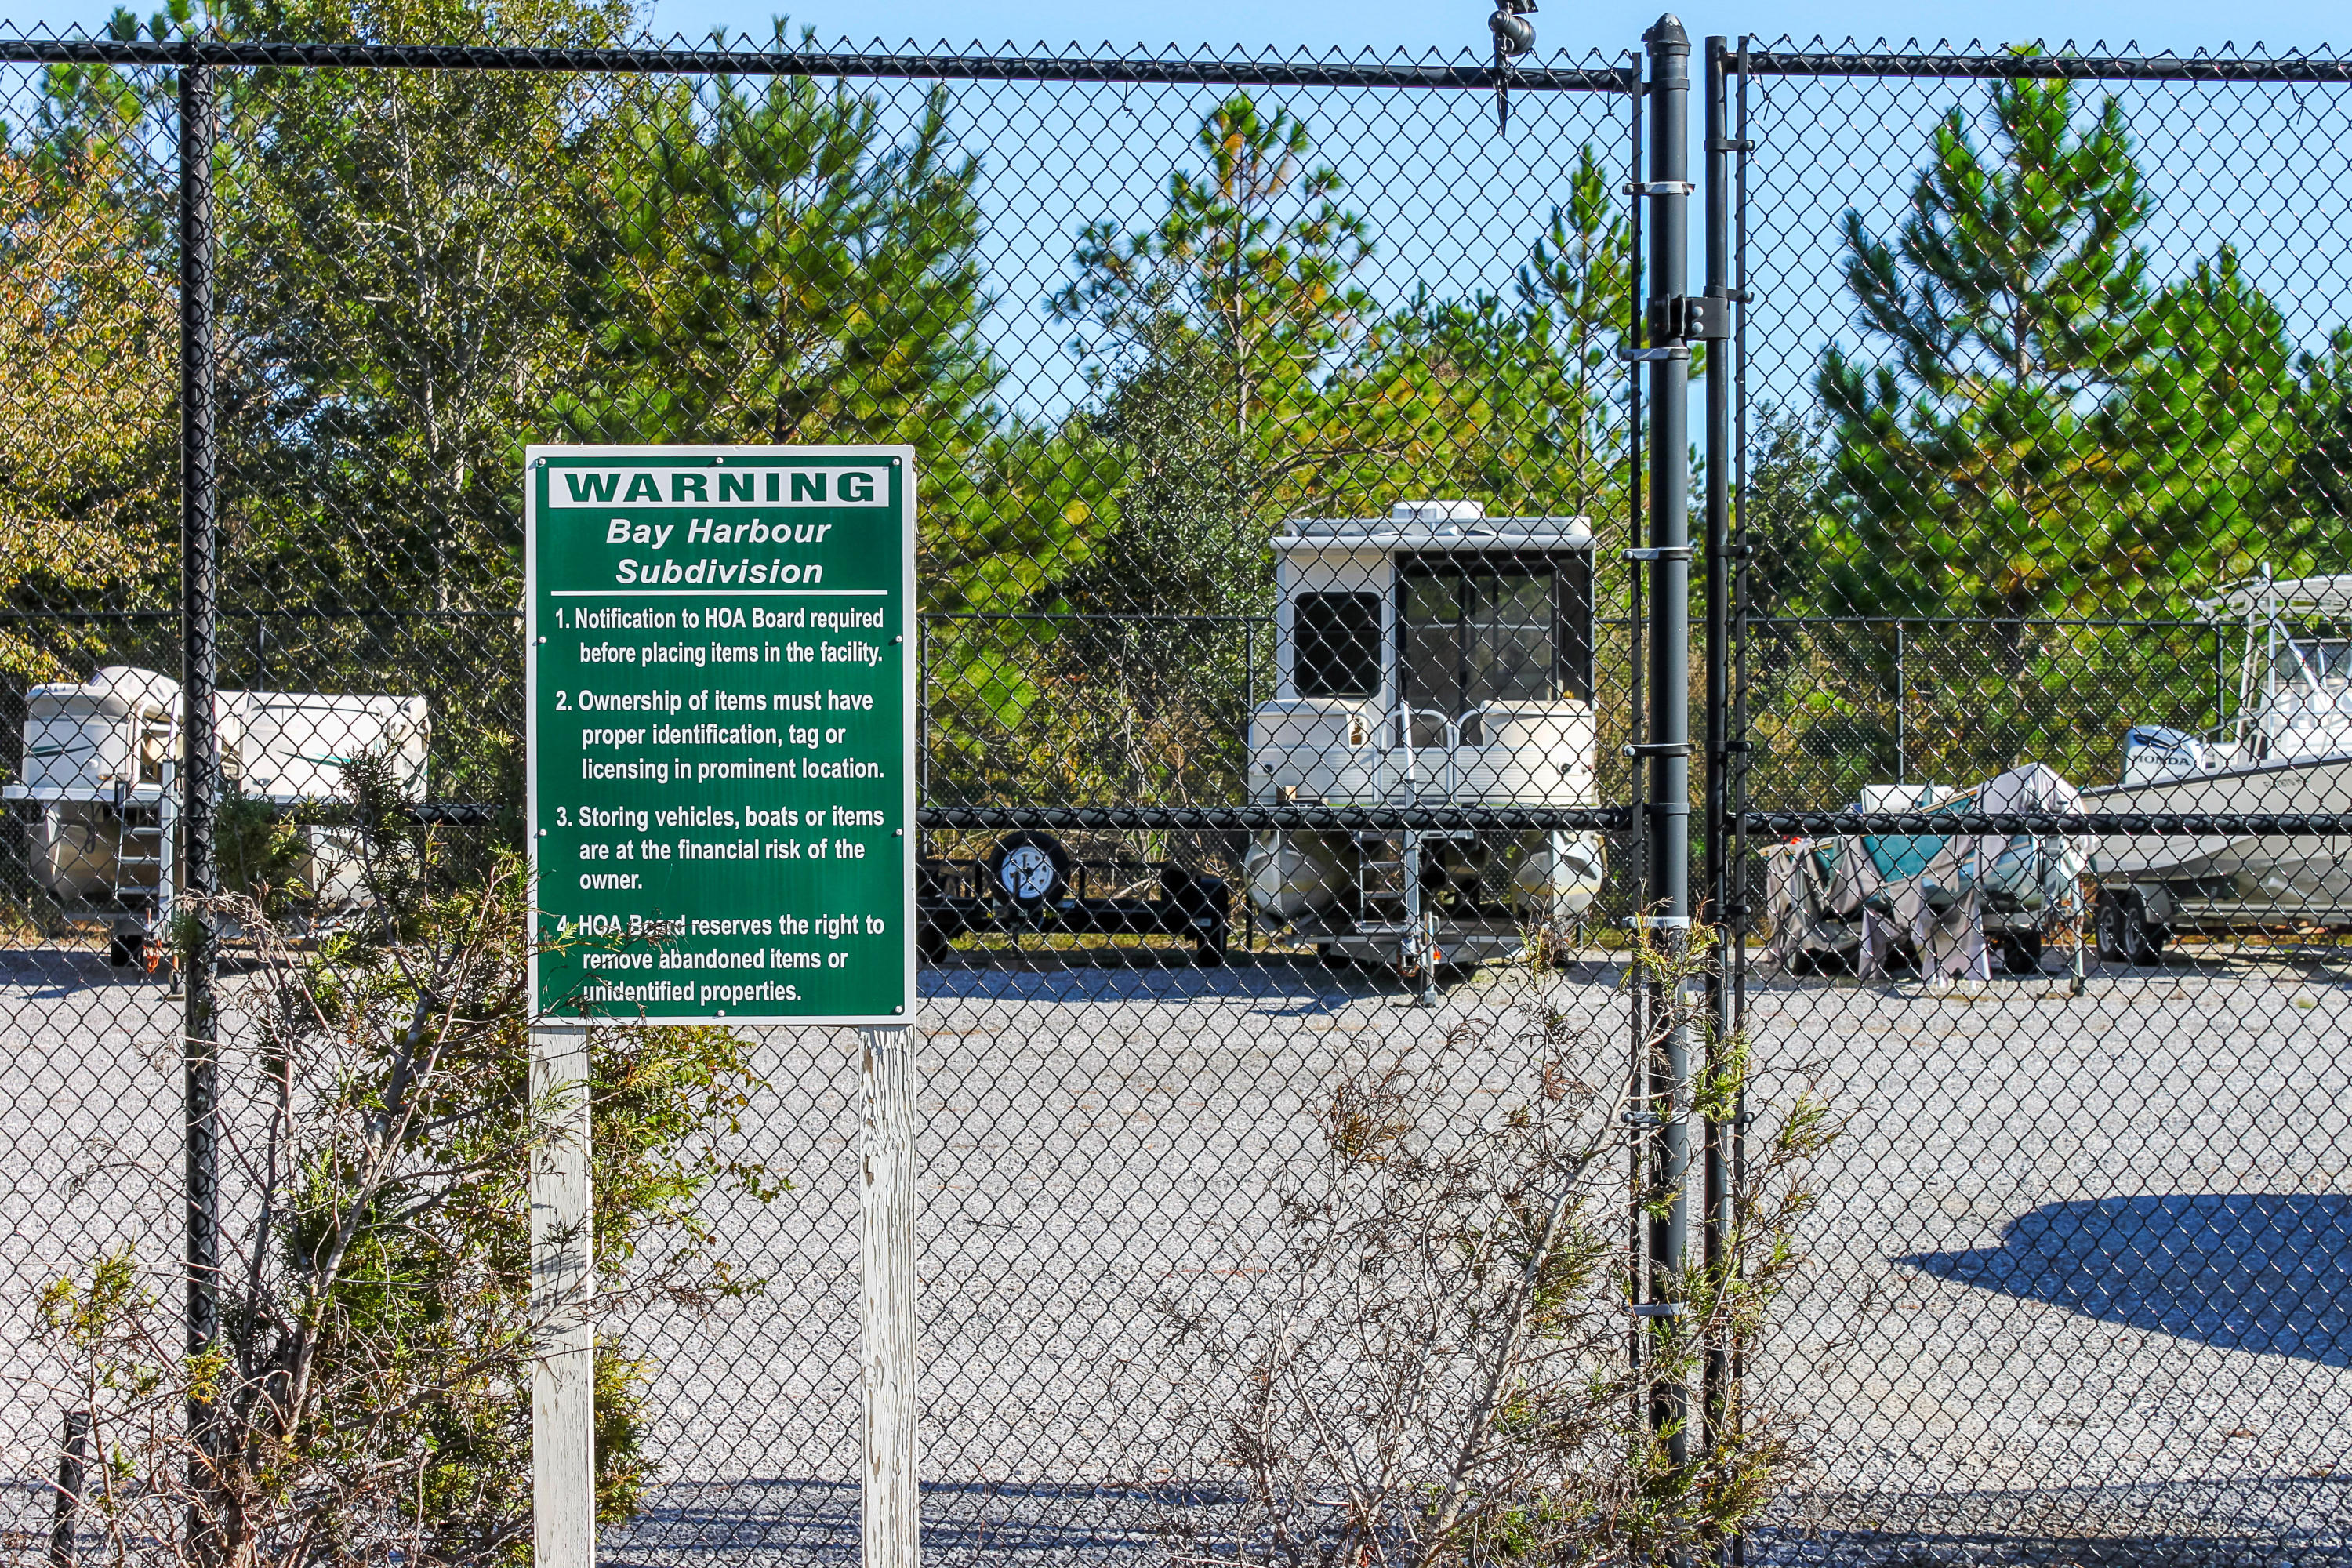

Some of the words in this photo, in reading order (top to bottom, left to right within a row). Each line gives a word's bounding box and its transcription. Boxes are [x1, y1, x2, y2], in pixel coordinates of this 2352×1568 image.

[564, 472, 874, 503] WARNING
[606, 518, 675, 550] Bay
[687, 518, 832, 543] Harbour
[615, 558, 823, 584] Subdivision
[555, 608, 570, 629] 1.
[575, 608, 676, 629] Notification
[682, 609, 699, 628] to
[705, 608, 746, 629] HOA
[753, 608, 804, 628] Board
[811, 608, 884, 633] required
[580, 642, 636, 663] before
[641, 642, 706, 667] placing
[711, 642, 759, 662] items
[764, 641, 780, 662] in
[786, 641, 815, 662] the
[820, 641, 883, 667] facility.
[555, 691, 572, 711] 2.
[578, 690, 682, 715] Ownership
[688, 690, 709, 710] of
[715, 690, 767, 710] items
[773, 691, 822, 710] must
[828, 690, 873, 710] have
[582, 728, 647, 750] proper
[652, 724, 782, 748] identification,
[789, 724, 819, 749] tag
[825, 728, 847, 744] or
[583, 758, 669, 783] licensing
[674, 758, 691, 779] in
[698, 758, 797, 783] prominent
[802, 758, 884, 779] location.
[556, 807, 572, 827] 3.
[579, 806, 648, 832] Storing
[655, 806, 739, 830] vehicles,
[746, 806, 799, 826] boats
[805, 810, 826, 826] or
[833, 805, 884, 826] items
[579, 844, 609, 860] are
[615, 840, 634, 860] at
[641, 840, 671, 860] the
[677, 839, 760, 860] financial
[765, 839, 801, 859] risk
[808, 838, 829, 859] of
[834, 839, 866, 859] the
[579, 873, 643, 890] owner.
[579, 914, 622, 936] HOA
[630, 914, 686, 935] Board
[691, 919, 773, 935] reserves
[779, 914, 809, 935] the
[815, 914, 859, 940] right
[865, 914, 885, 935] to
[583, 952, 653, 969] remove
[659, 948, 764, 969] abandoned
[770, 948, 822, 969] items
[827, 952, 848, 969] or
[583, 981, 695, 1002] unidentified
[700, 981, 802, 1007] properties.
